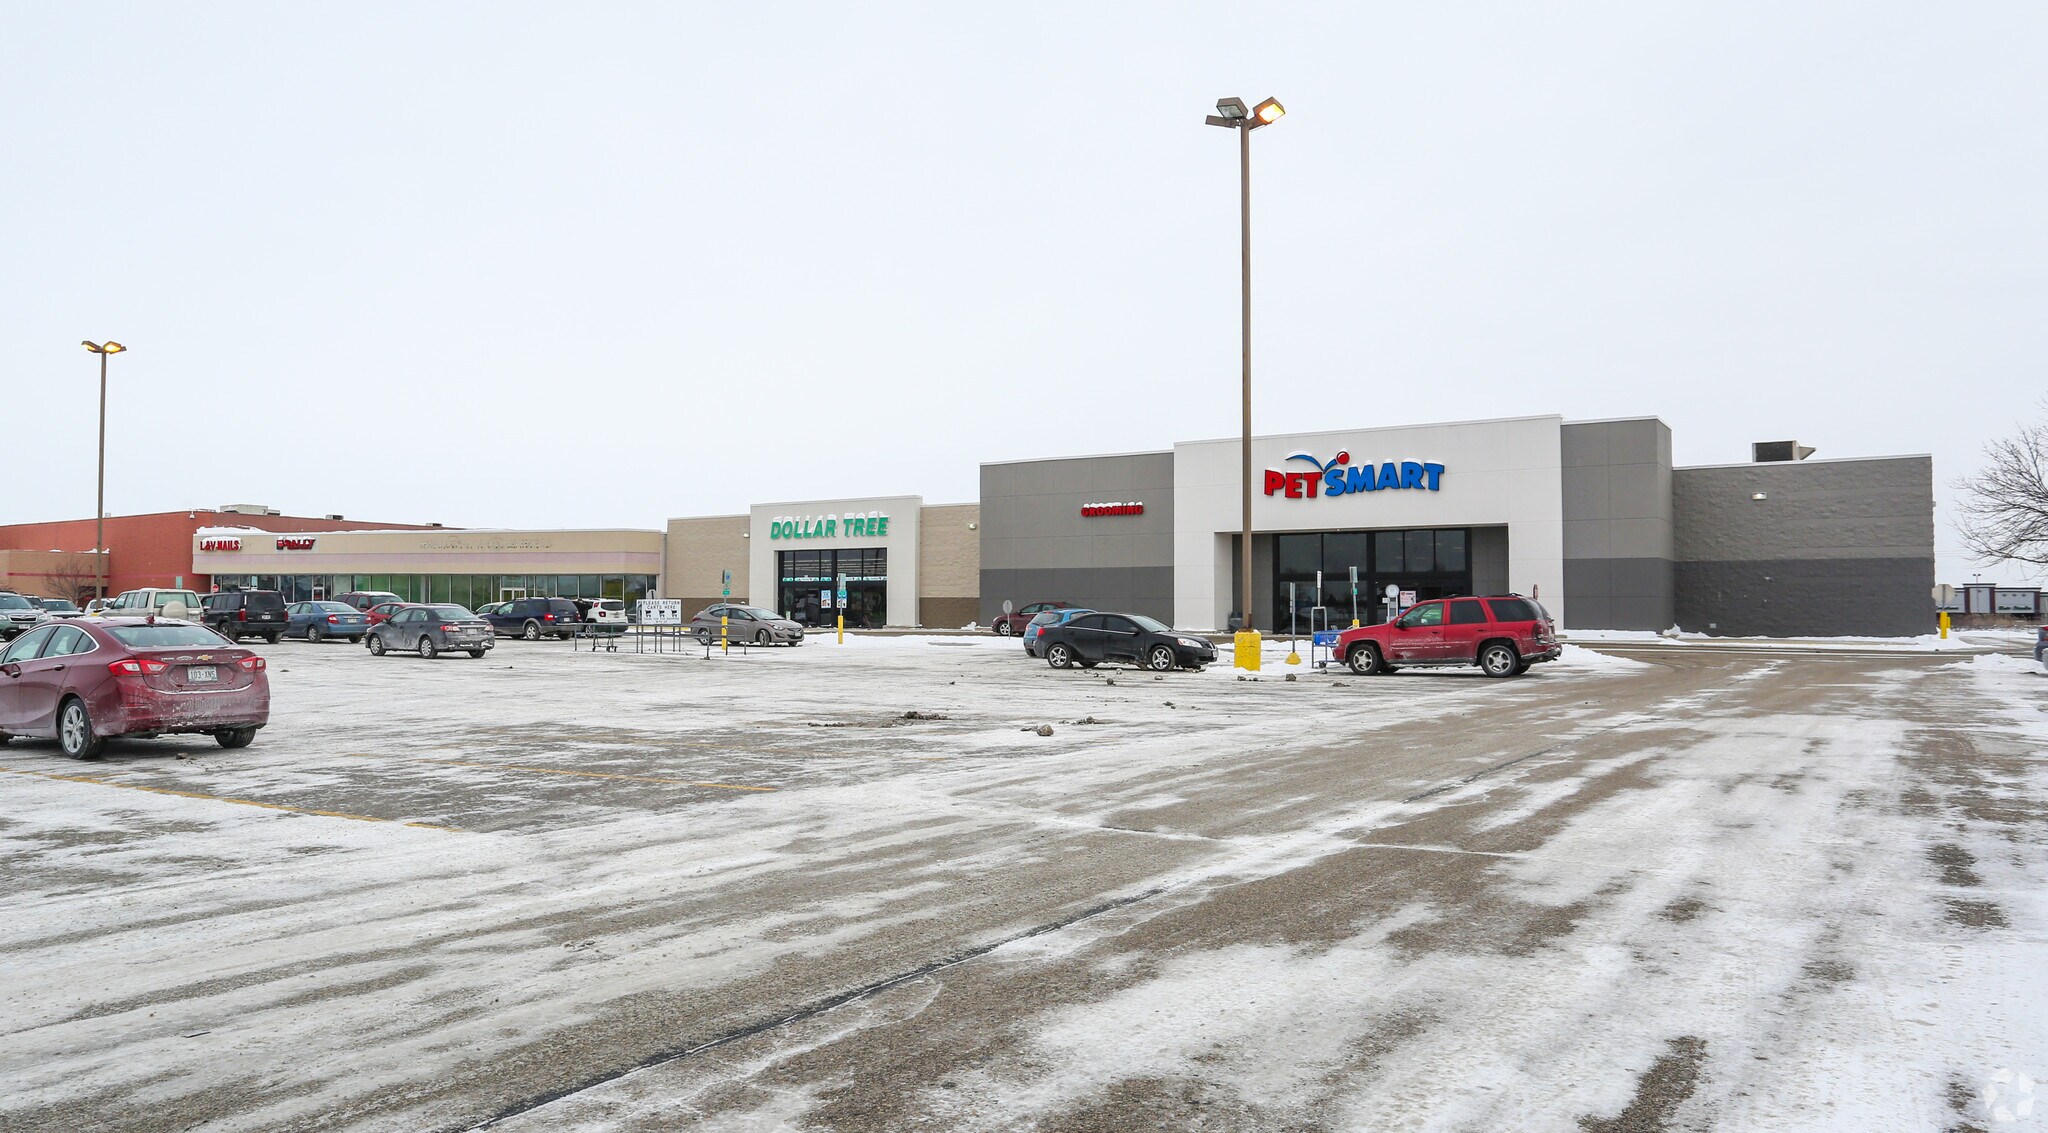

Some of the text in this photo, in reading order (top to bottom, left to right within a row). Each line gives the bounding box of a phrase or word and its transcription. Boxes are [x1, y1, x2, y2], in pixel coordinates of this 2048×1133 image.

[1081, 504, 1144, 517] GROOMING
[770, 517, 888, 539] DOLLAR TREE
[217, 540, 240, 551] NAILS
[190, 670, 215, 679] 103-XNS
